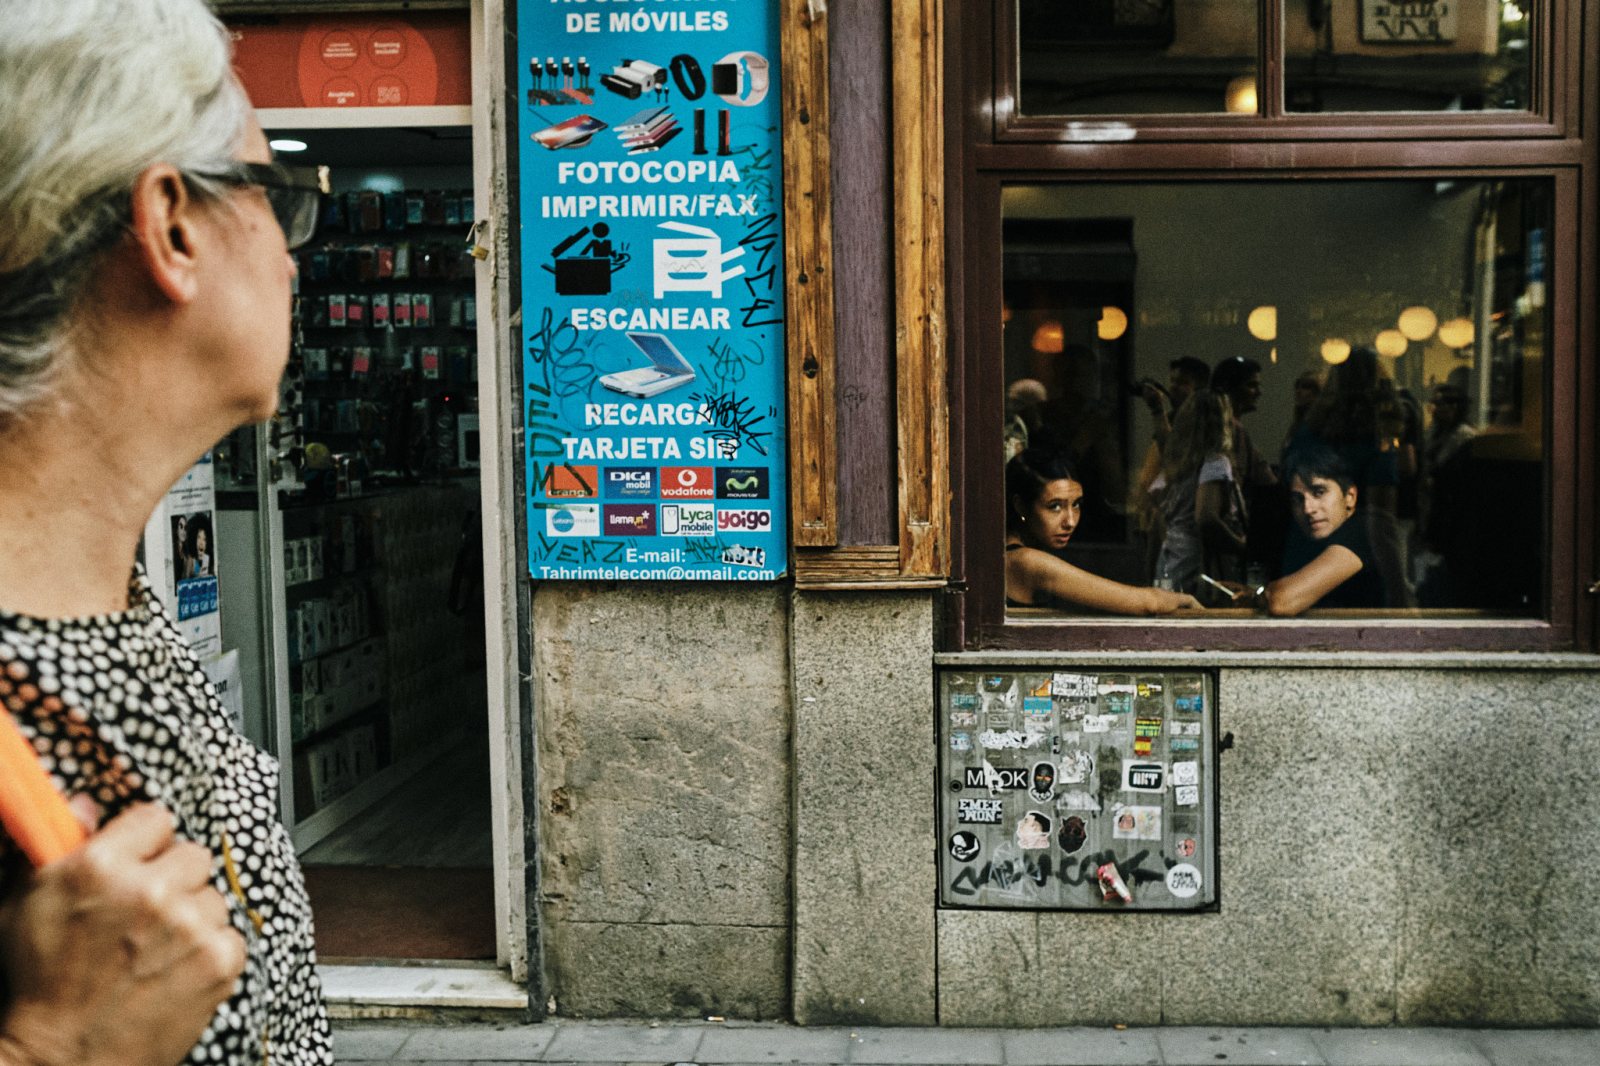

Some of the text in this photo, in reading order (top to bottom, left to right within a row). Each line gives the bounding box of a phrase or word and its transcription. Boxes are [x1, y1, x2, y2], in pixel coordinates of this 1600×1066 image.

[566, 7, 729, 33] DE MÓVILES
[558, 160, 741, 184] FOTOCOPIA
[542, 194, 758, 218] IMPRIMIR/FAX
[571, 307, 731, 331] ESCANEAR
[585, 403, 715, 426] RECARGA
[561, 437, 682, 460] TARJETA
[610, 471, 650, 481] DIGI
[625, 481, 651, 489] mobil
[661, 487, 714, 497] vodafone
[680, 508, 713, 523] Lyca
[717, 511, 770, 530] yoigo
[680, 522, 714, 532] mobile
[626, 548, 686, 563] E-mail:
